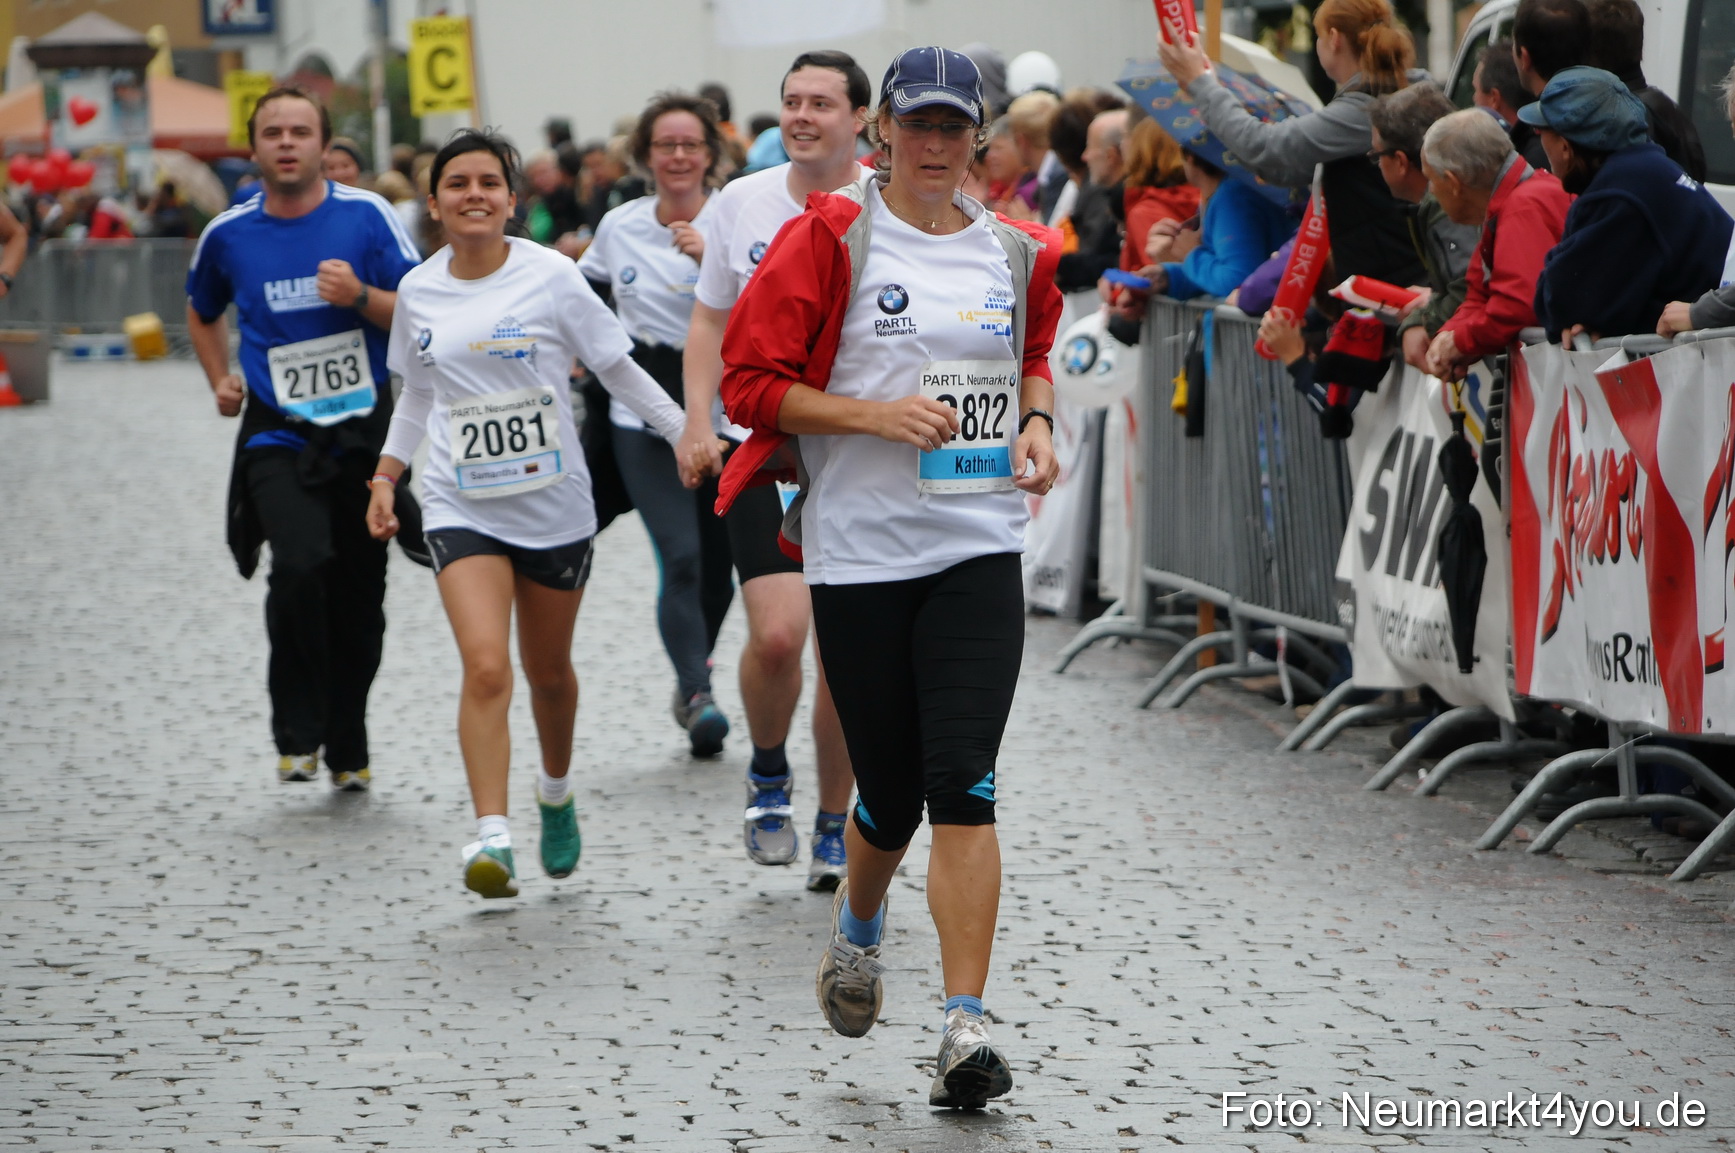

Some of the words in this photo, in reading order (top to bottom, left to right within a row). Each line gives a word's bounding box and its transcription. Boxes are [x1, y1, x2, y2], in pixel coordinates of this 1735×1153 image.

[426, 45, 458, 91] C
[1287, 243, 1318, 289] BKK
[874, 317, 917, 330] PARTL
[957, 310, 978, 322] 14.
[876, 327, 918, 338] Neumarkt
[284, 354, 361, 399] 2763
[923, 374, 964, 386] PARTL
[967, 374, 1007, 386] Neumarkt
[451, 406, 482, 419] PARTL
[484, 398, 537, 414] Neumarkt
[461, 411, 546, 460] 2081
[470, 466, 518, 480] Samantha
[955, 454, 997, 474] Kathrin
[1359, 424, 1454, 588] SW
